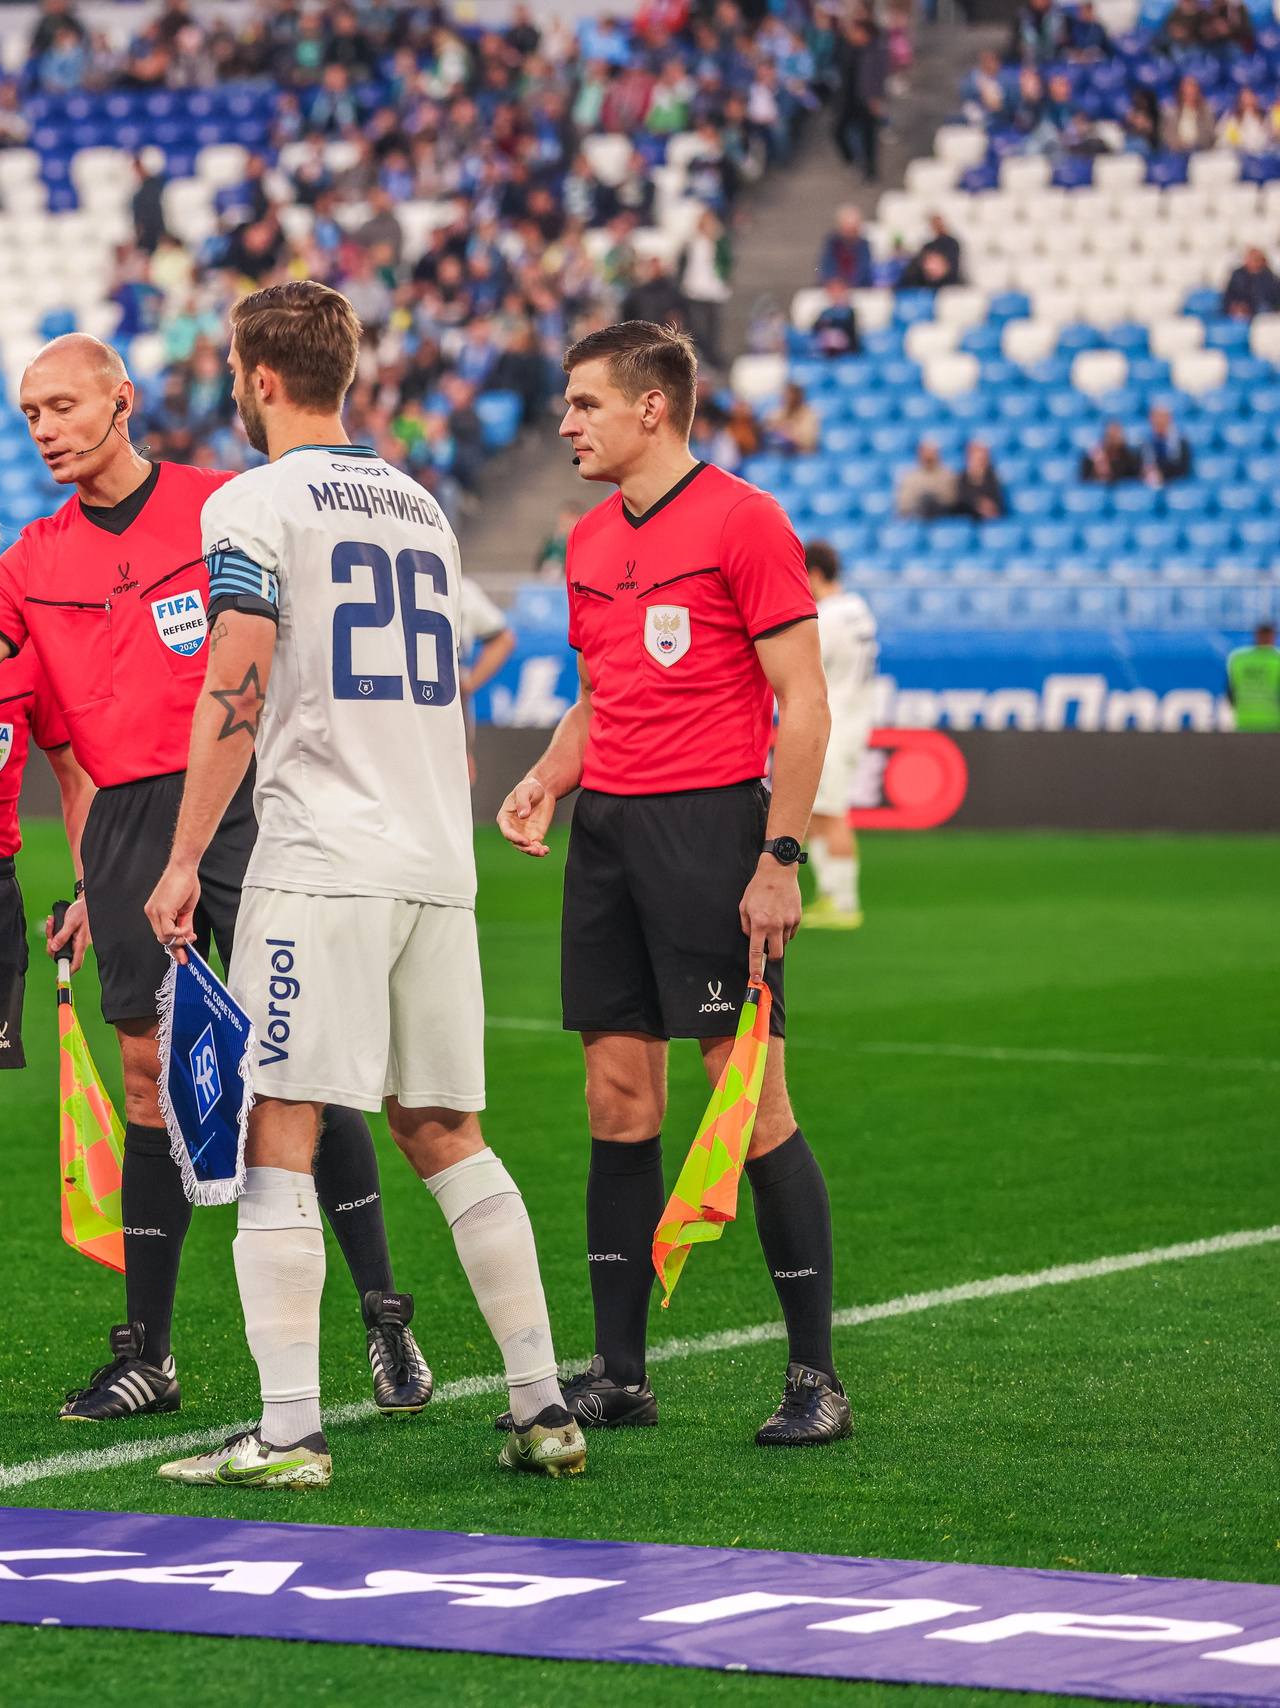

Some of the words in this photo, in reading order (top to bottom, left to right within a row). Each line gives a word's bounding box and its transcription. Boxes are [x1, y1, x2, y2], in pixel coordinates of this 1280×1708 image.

[307, 481, 444, 533] МЕЩАНИНОВ
[156, 595, 199, 620] FIFA
[162, 618, 205, 637] REFEREE
[331, 541, 456, 707] 26
[178, 640, 199, 653] 2026
[203, 994, 223, 1021] САМАРА
[258, 938, 301, 1067] Vorgol
